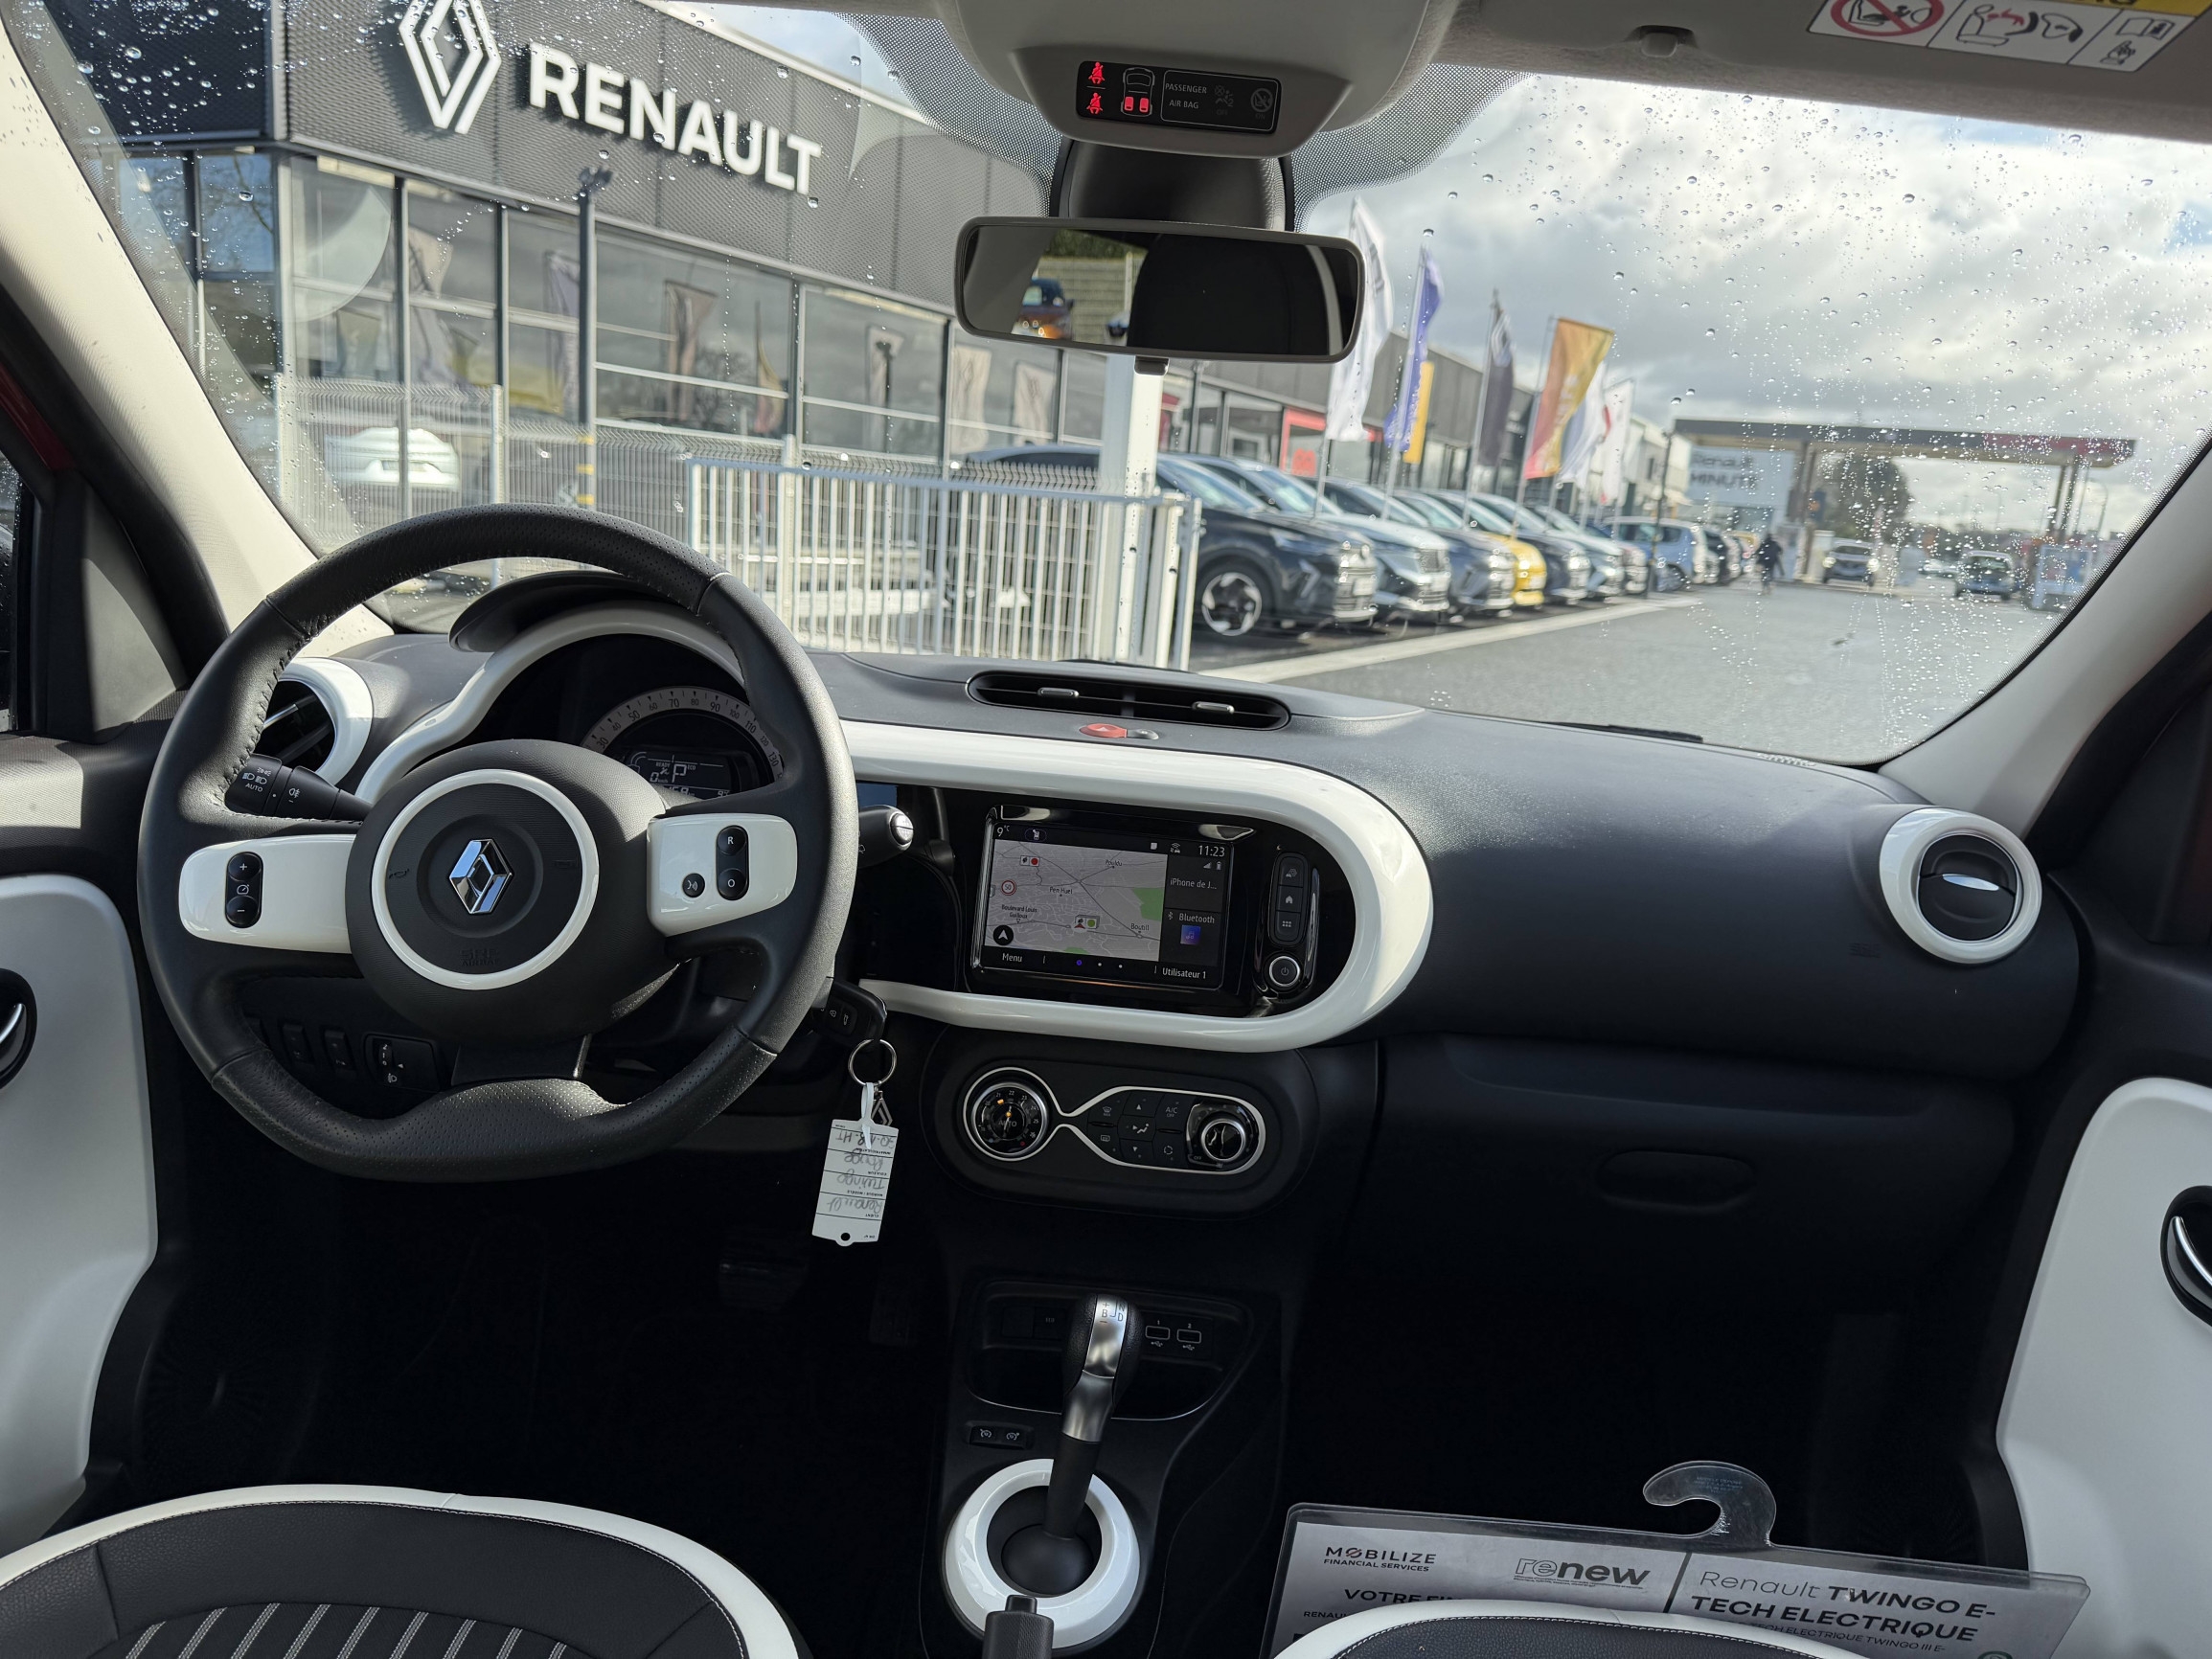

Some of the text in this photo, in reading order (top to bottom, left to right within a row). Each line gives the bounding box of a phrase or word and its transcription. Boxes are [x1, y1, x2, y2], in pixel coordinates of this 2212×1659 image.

[1165, 82, 1207, 95] PASSENGER
[1169, 100, 1198, 109] AIR BAG
[528, 41, 822, 194] RENAULT
[649, 702, 658, 711] 60
[669, 698, 680, 708] 70
[710, 701, 720, 713] 90
[628, 710, 641, 721] 50
[729, 708, 741, 718] 100
[611, 722, 622, 732] 40
[744, 720, 756, 734] 110
[596, 737, 609, 749] 30
[768, 751, 780, 767] 130
[245, 783, 263, 792] AUTO
[1198, 845, 1225, 857] 11:23
[1170, 877, 1196, 887] iPhone
[1178, 913, 1215, 924] Bluetooth
[1002, 952, 1023, 963] Menu
[1162, 966, 1206, 979] Utilisateur 1
[1117, 1312, 1124, 1322] D
[1323, 1558, 1430, 1572] FINANCIAL SERVICES
[1516, 1557, 1651, 1586] renew
[1344, 1588, 1422, 1604] VOTRE
[1699, 1571, 1995, 1619] Renault TWINGO E-
[1691, 1595, 1978, 1642] TECH ELECTRIQUE
[1786, 1626, 1864, 1643] ELECTRIQUE
[1867, 1636, 1921, 1650] TWINGO
